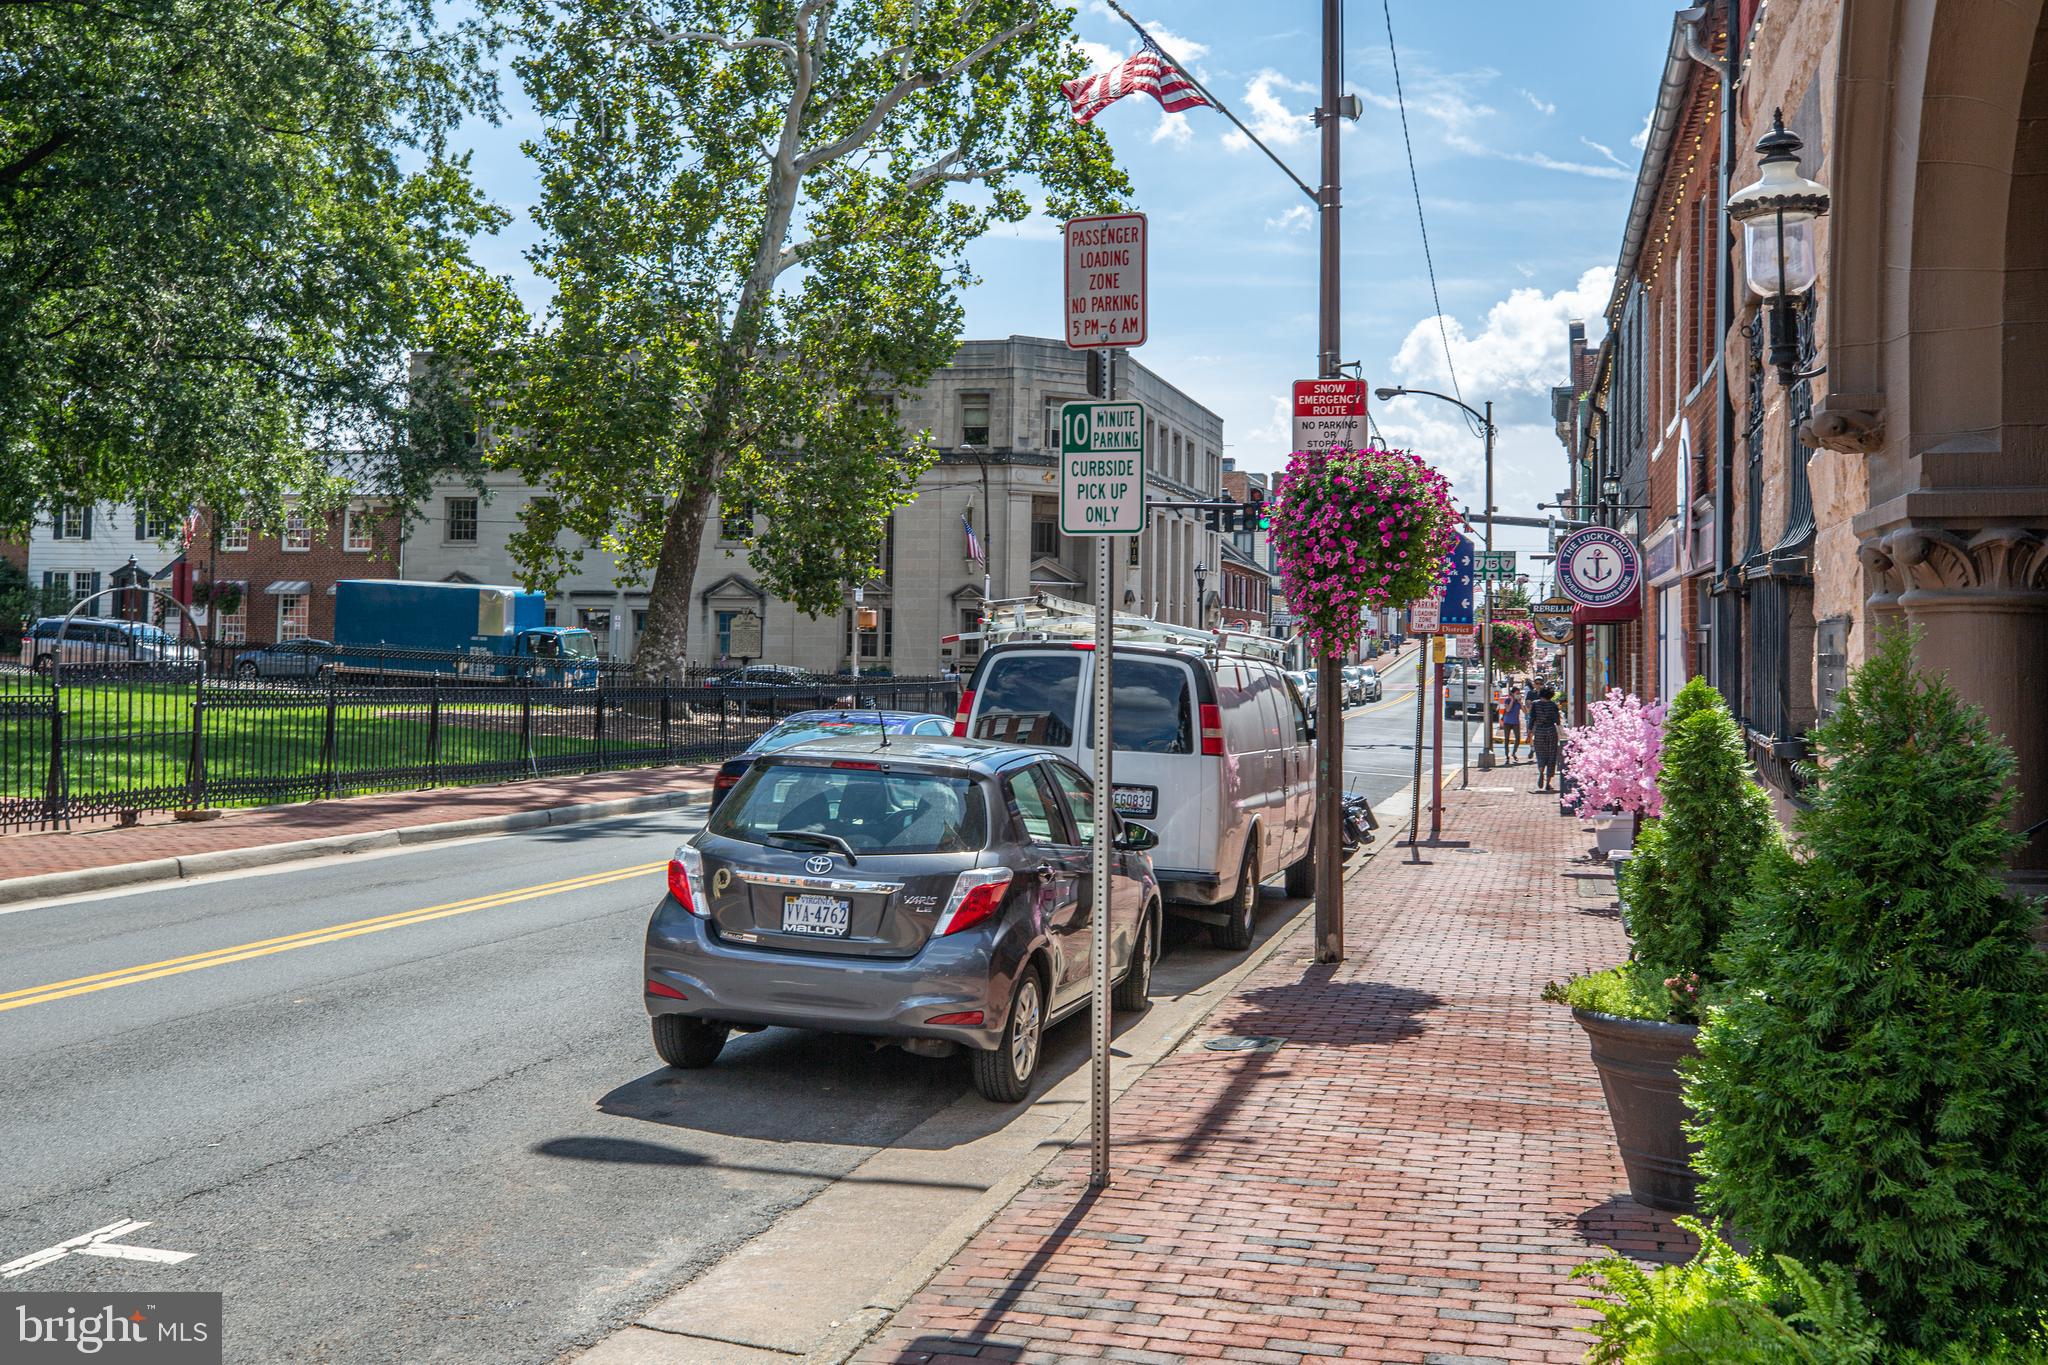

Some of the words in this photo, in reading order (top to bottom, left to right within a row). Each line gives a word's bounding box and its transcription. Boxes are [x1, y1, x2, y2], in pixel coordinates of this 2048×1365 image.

[1072, 227, 1139, 247] PASSENGER
[1080, 250, 1130, 268] LOADING
[1089, 273, 1120, 290] ZONE
[1072, 298, 1086, 314] NO
[1091, 294, 1139, 312] PARKING
[1073, 320, 1080, 336] 5
[1121, 317, 1138, 333] AM
[1314, 384, 1346, 394] SNOW
[1298, 395, 1361, 404] EMERGENCY
[1312, 405, 1348, 415] ROUTE
[1097, 411, 1135, 428] MINUTE
[1302, 421, 1316, 430] NO
[1318, 421, 1358, 430] PARKING
[1064, 413, 1089, 445] 10
[1323, 431, 1337, 439] OR
[1093, 431, 1139, 448] PARKING
[1307, 440, 1354, 448] STOPPING
[1071, 460, 1134, 477] CURBSIDE
[1077, 484, 1106, 500] PICK
[1111, 483, 1128, 499] UP
[1086, 506, 1119, 522] ONLY
[1563, 541, 1578, 559] THE
[1578, 533, 1611, 544] LUCKY
[1611, 538, 1632, 558] KNOT
[1476, 560, 1481, 568] 7
[1487, 560, 1498, 569] 15
[1504, 560, 1511, 568] 7
[1563, 574, 1594, 601] ADVENTURE
[1595, 590, 1619, 602] STARTS
[1619, 575, 1632, 592] HERE
[801, 896, 834, 906] VIRGINIA
[904, 895, 938, 906] YARIS
[787, 904, 847, 924] VVA-4762
